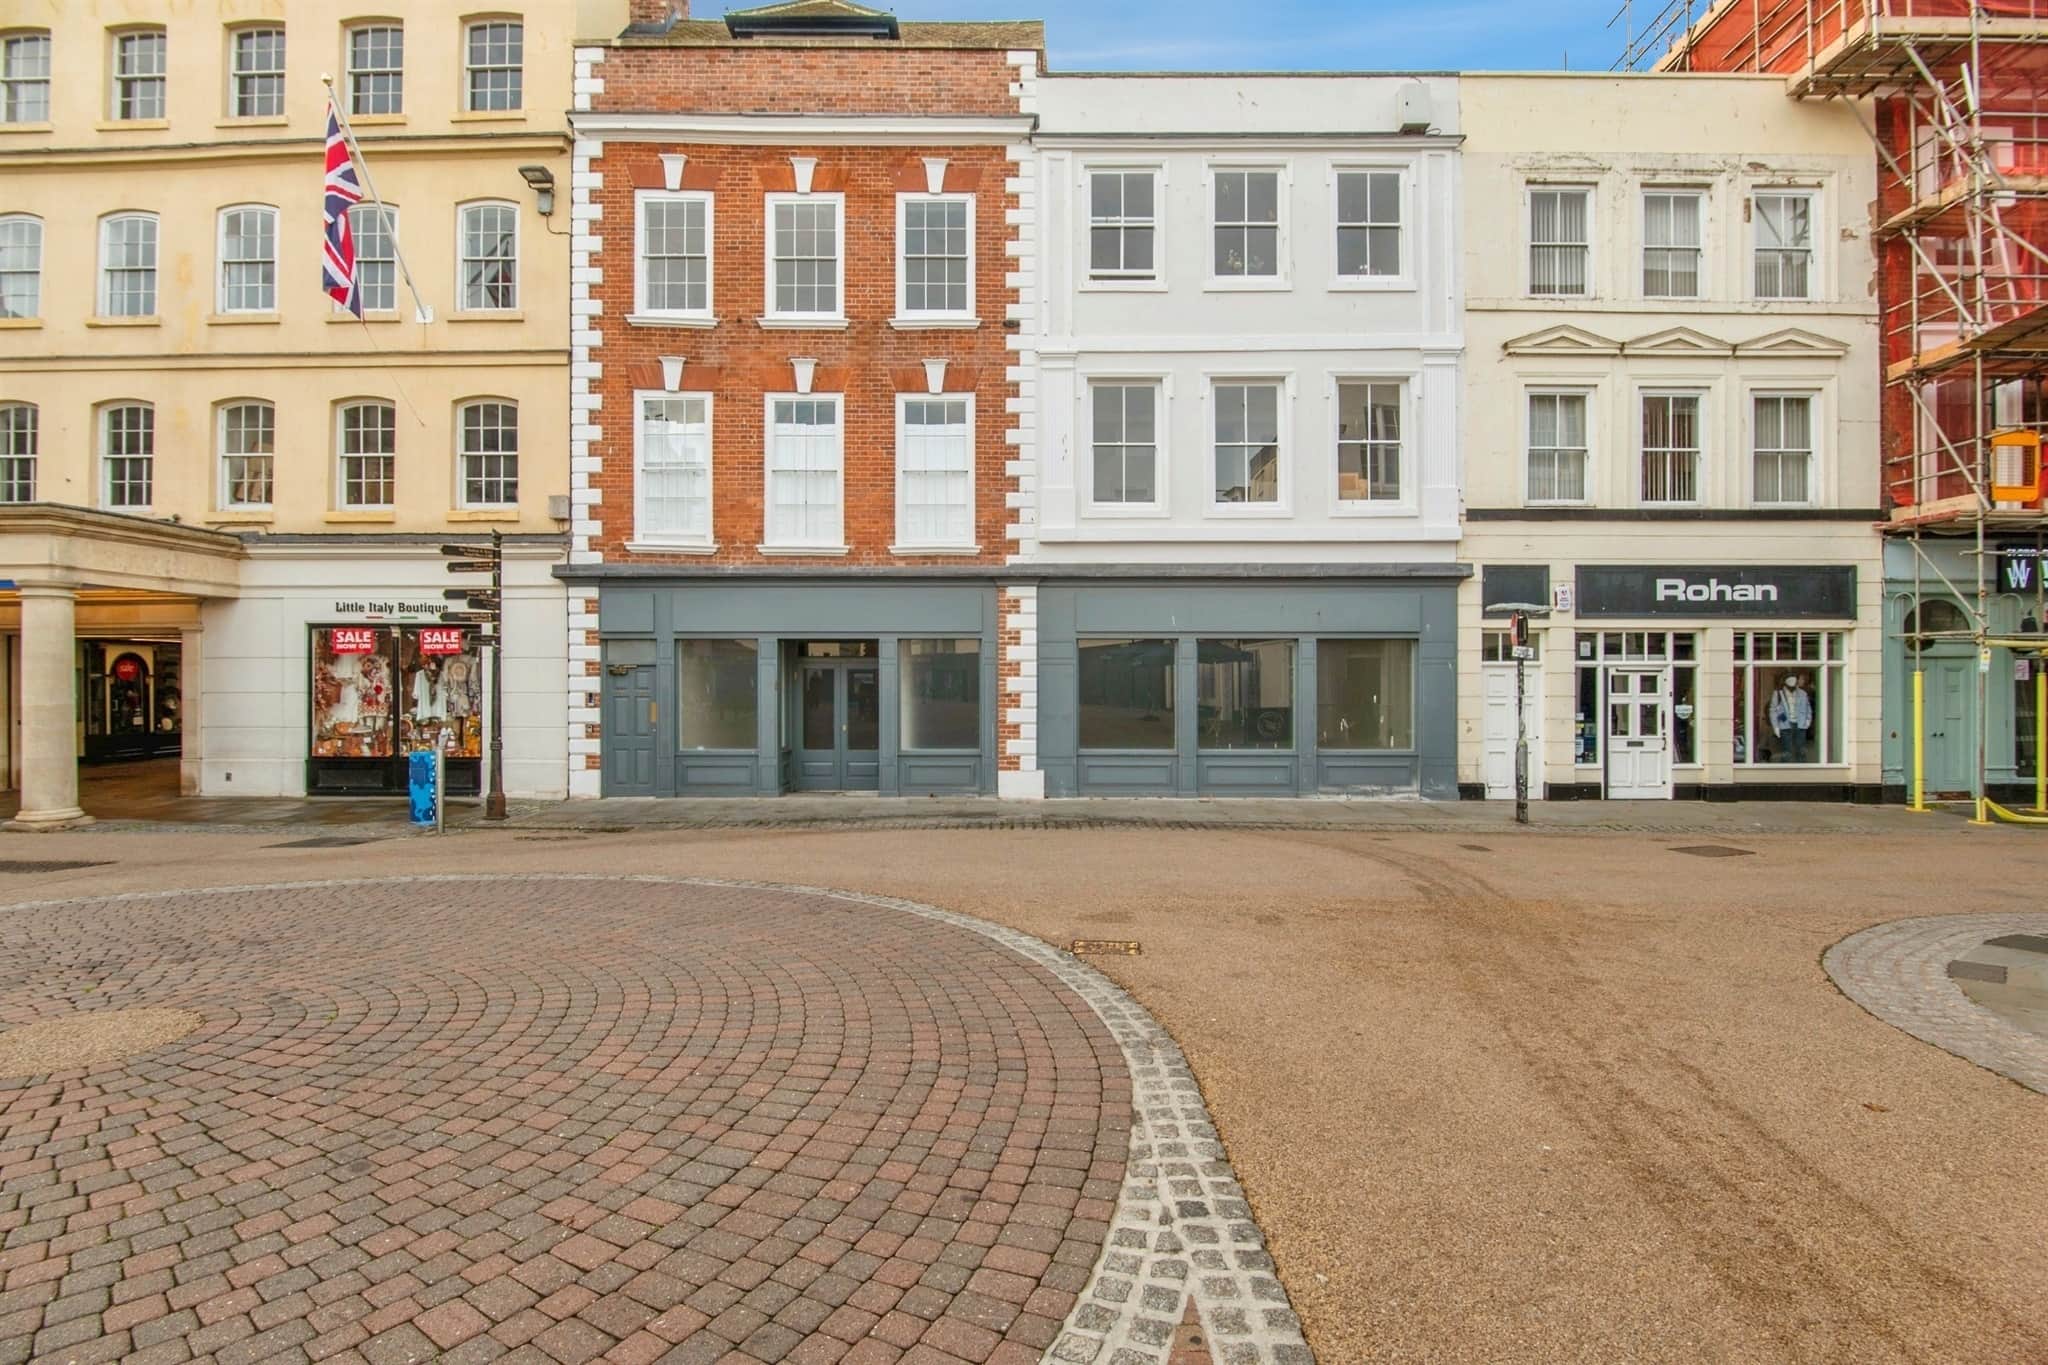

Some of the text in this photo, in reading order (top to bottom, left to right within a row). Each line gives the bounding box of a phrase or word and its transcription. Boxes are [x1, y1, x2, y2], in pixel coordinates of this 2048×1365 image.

[1656, 578, 1778, 601] Rohan
[335, 602, 449, 614] Little Italy Boutique
[336, 631, 371, 643] SALE
[423, 631, 459, 643] SALE
